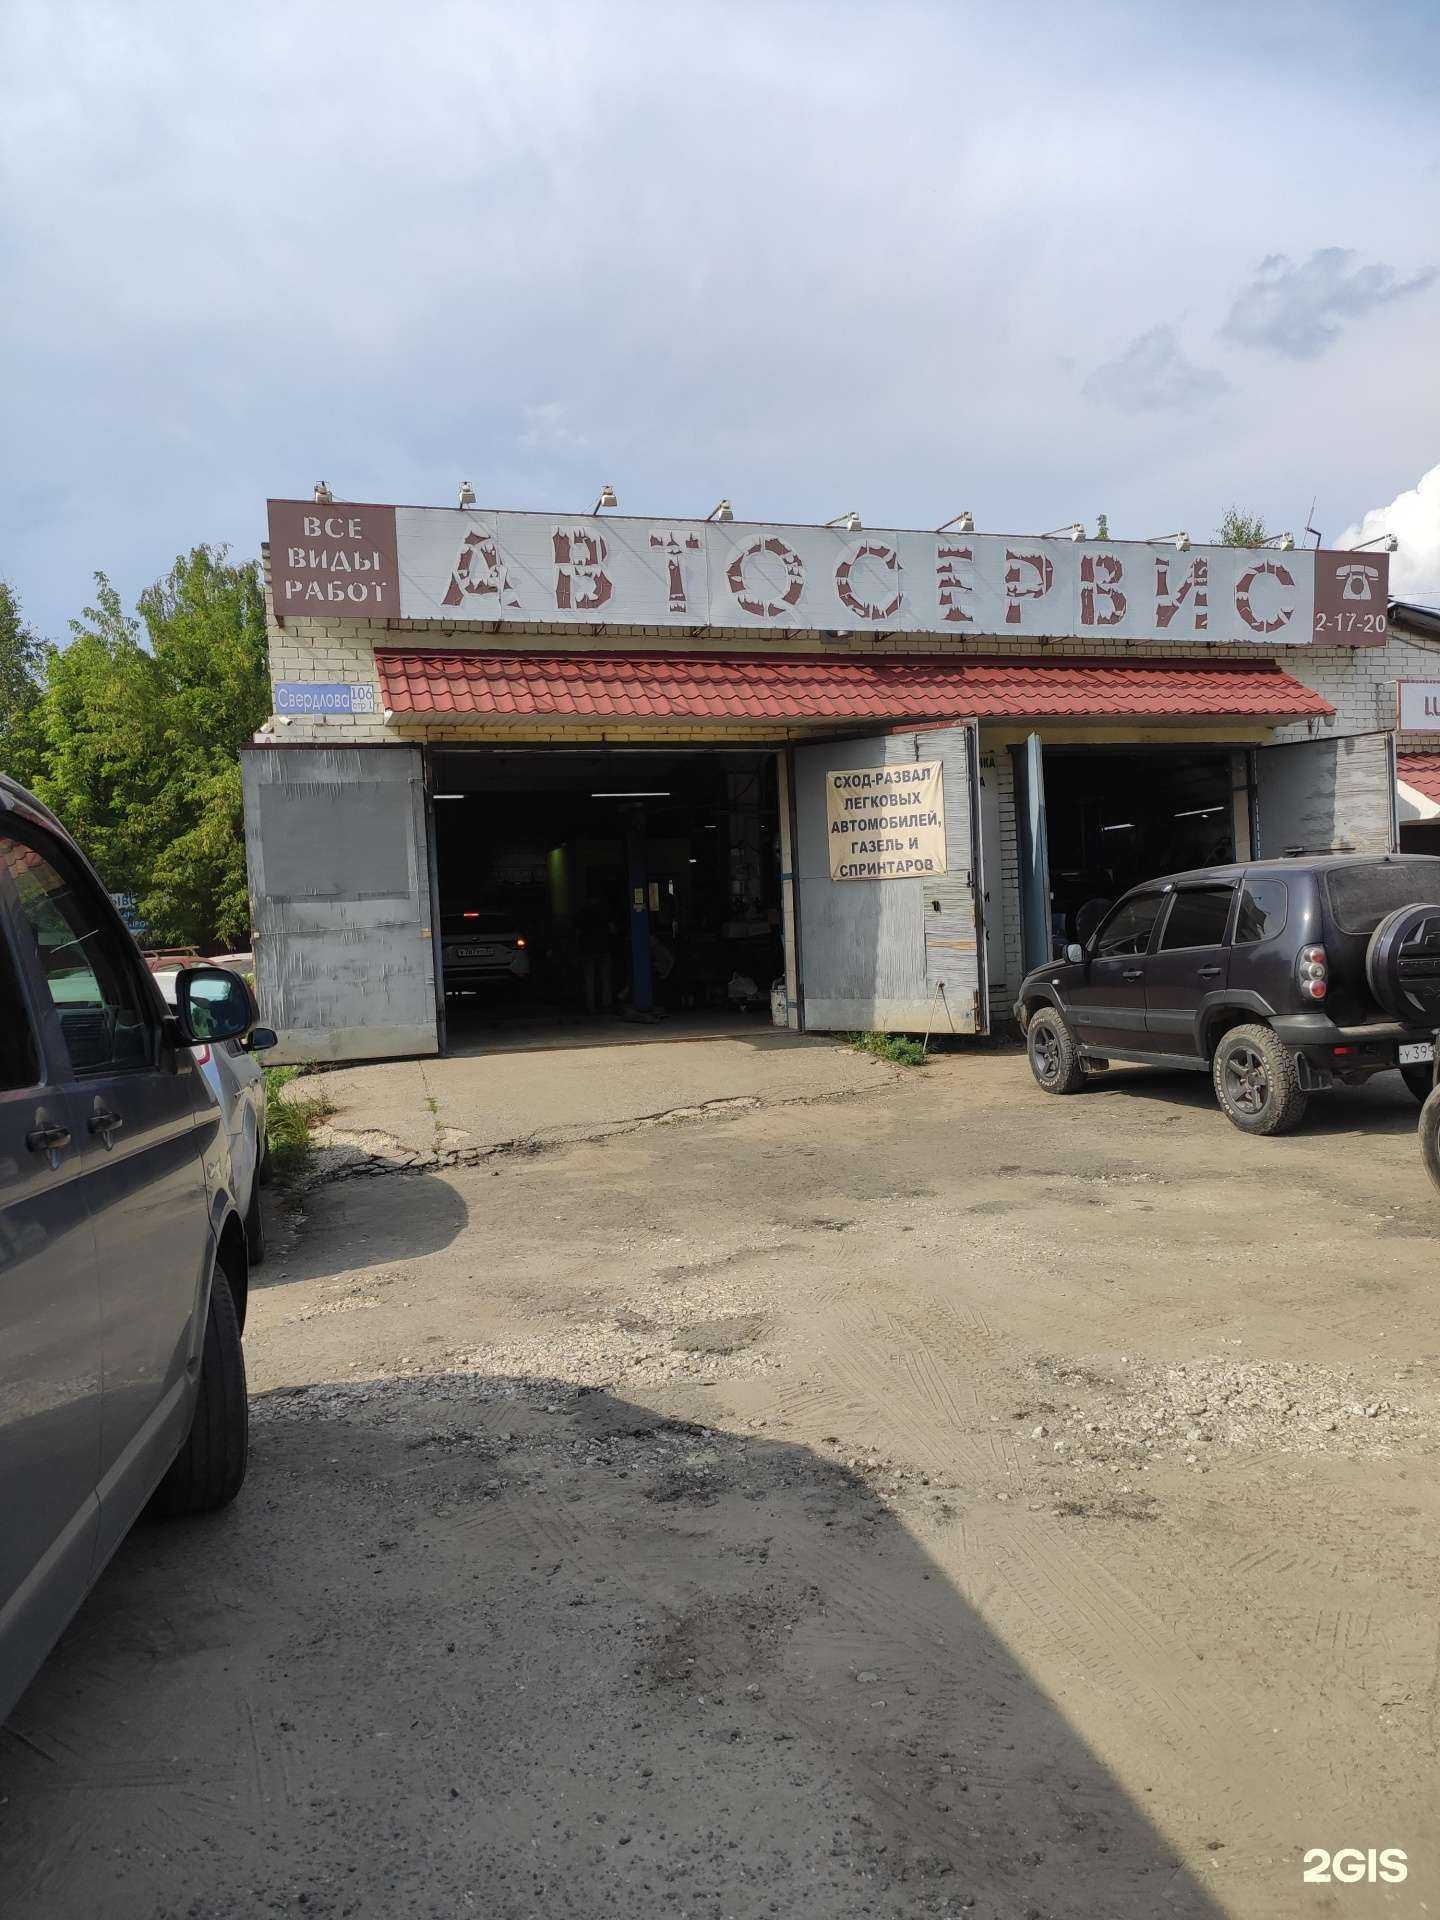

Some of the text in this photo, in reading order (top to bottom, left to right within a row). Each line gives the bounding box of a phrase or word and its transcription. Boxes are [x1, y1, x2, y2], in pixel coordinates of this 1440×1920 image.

[303, 516, 362, 539] ВСЕ
[288, 547, 380, 572] ВИДЫ
[285, 579, 387, 602] РАБОТ
[441, 527, 1296, 634] АВТОСЕРВИС
[1315, 612, 1386, 633] 2-17-20
[278, 686, 373, 712] Свердлова 106
[833, 767, 931, 789] СХОД-РАЗВАЛ
[844, 791, 922, 810] ЛЕГКОВЫХ
[831, 809, 942, 834] АВТОМОБИЛЕЙ,
[851, 837, 919, 854] ГАЗЕЛЬ И
[839, 858, 934, 877] СПРИНТАРОВ
